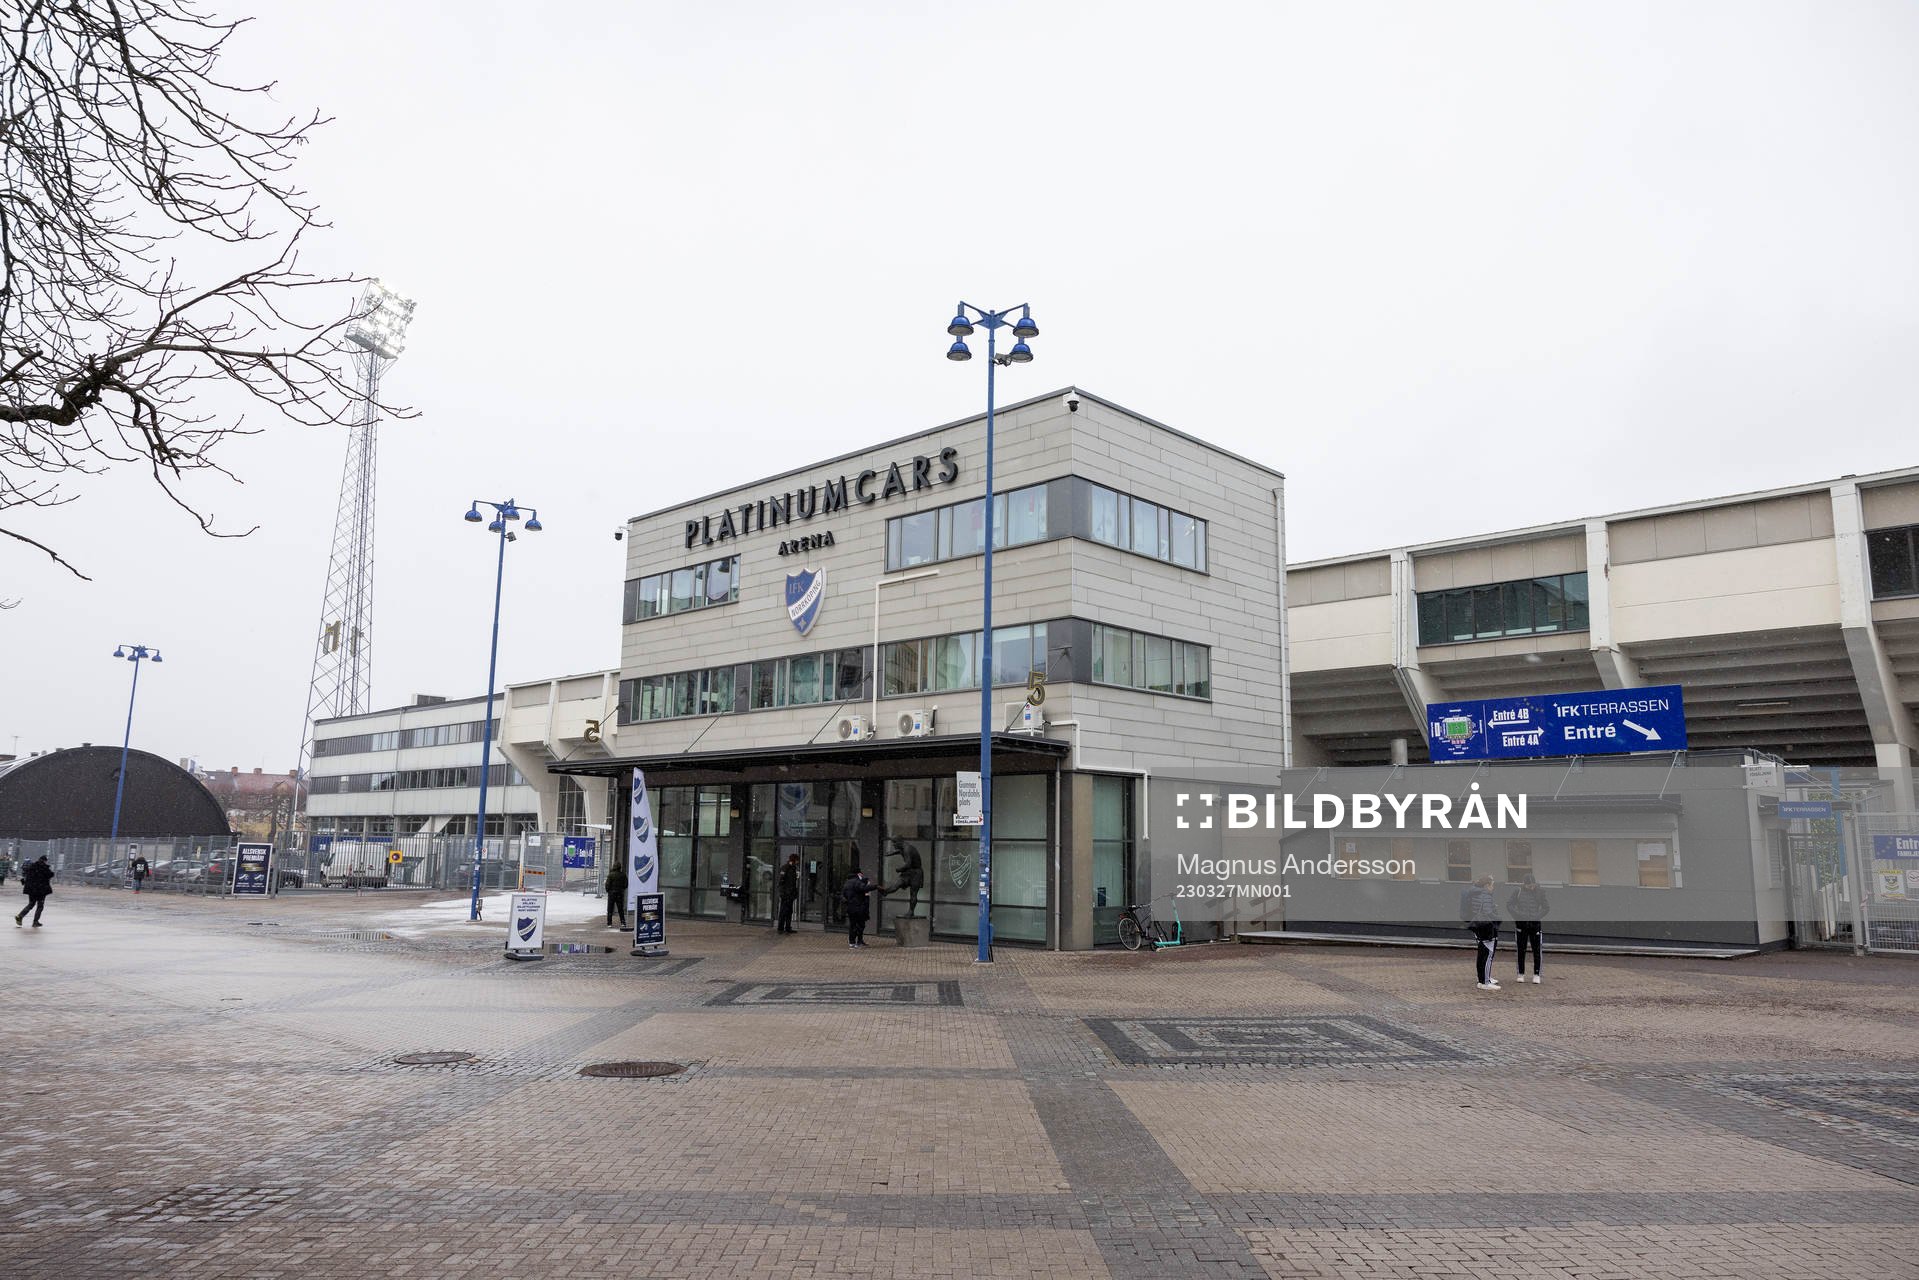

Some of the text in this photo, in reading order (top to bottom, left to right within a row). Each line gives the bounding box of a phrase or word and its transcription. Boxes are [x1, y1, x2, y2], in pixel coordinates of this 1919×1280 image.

[685, 447, 958, 548] PLATINUMCARS
[778, 530, 836, 555] ARENA
[790, 582, 804, 593] IFK
[1027, 671, 1045, 706] 5
[1493, 708, 1530, 720] Entré 4B
[1564, 723, 1616, 740] Entré
[1502, 734, 1539, 747] Entré 4A
